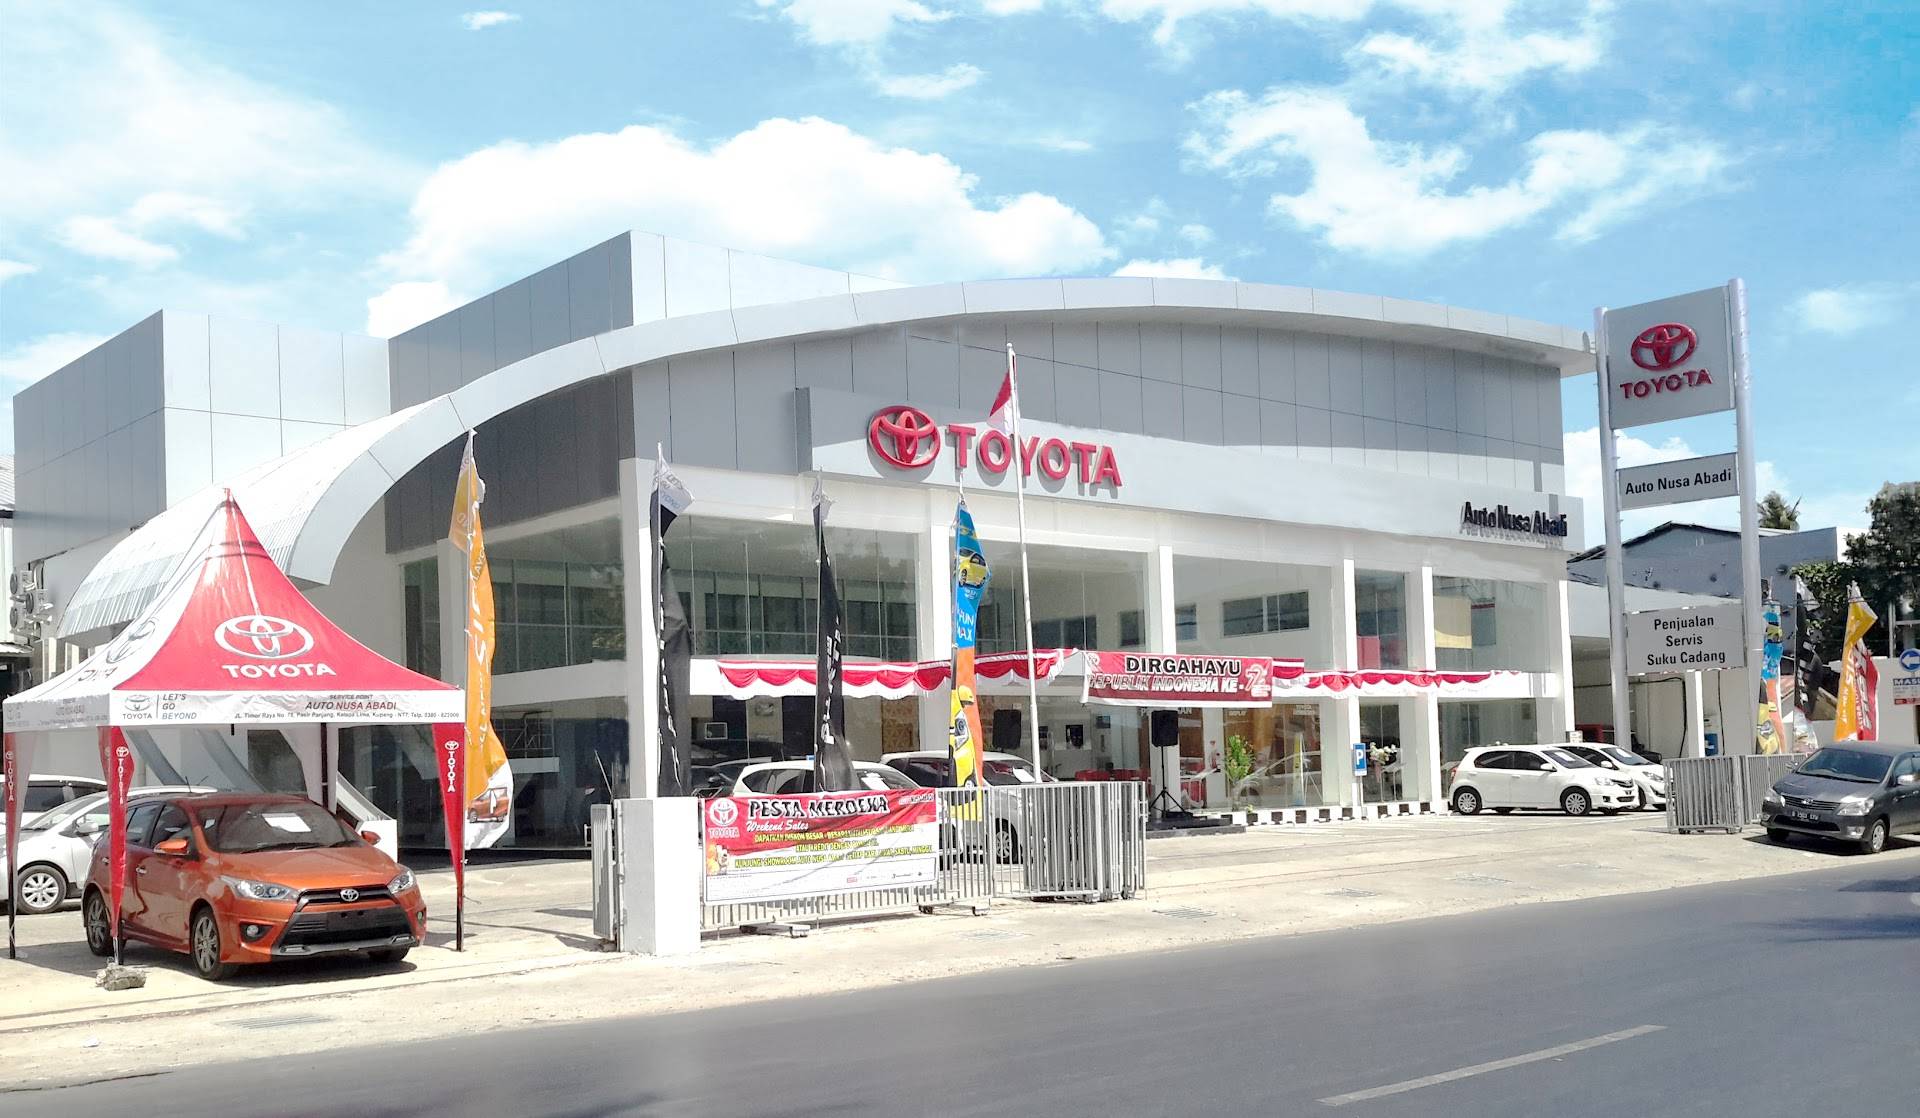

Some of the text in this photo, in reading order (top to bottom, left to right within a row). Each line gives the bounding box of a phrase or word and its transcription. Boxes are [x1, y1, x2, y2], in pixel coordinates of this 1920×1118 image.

[1620, 368, 1713, 399] TOYOTA
[948, 423, 1123, 487] TOYOTA
[1625, 468, 1732, 495] Auto Nusa Abadi
[1463, 501, 1496, 528] Auto
[1497, 504, 1531, 532] Nusa
[1654, 616, 1714, 631] Penjualan
[1666, 633, 1703, 647] Servis
[1125, 656, 1241, 676] DIRGAHAYU
[1647, 651, 1726, 666] Suku Cadang
[222, 663, 337, 678] TOYOTA
[1151, 675, 1220, 693] INDONESIA
[162, 693, 187, 701] LET'S
[162, 702, 176, 710] GO
[305, 701, 397, 710] AUTO NUSA ABADI
[161, 711, 198, 720] BEYOND
[1356, 748, 1365, 766] P
[447, 750, 456, 793] TOYOTA
[749, 799, 806, 819] PESTA
[809, 795, 889, 818] MERDEKA
[708, 827, 740, 839] TOYOTA
[746, 819, 809, 832] Weekend Sales
